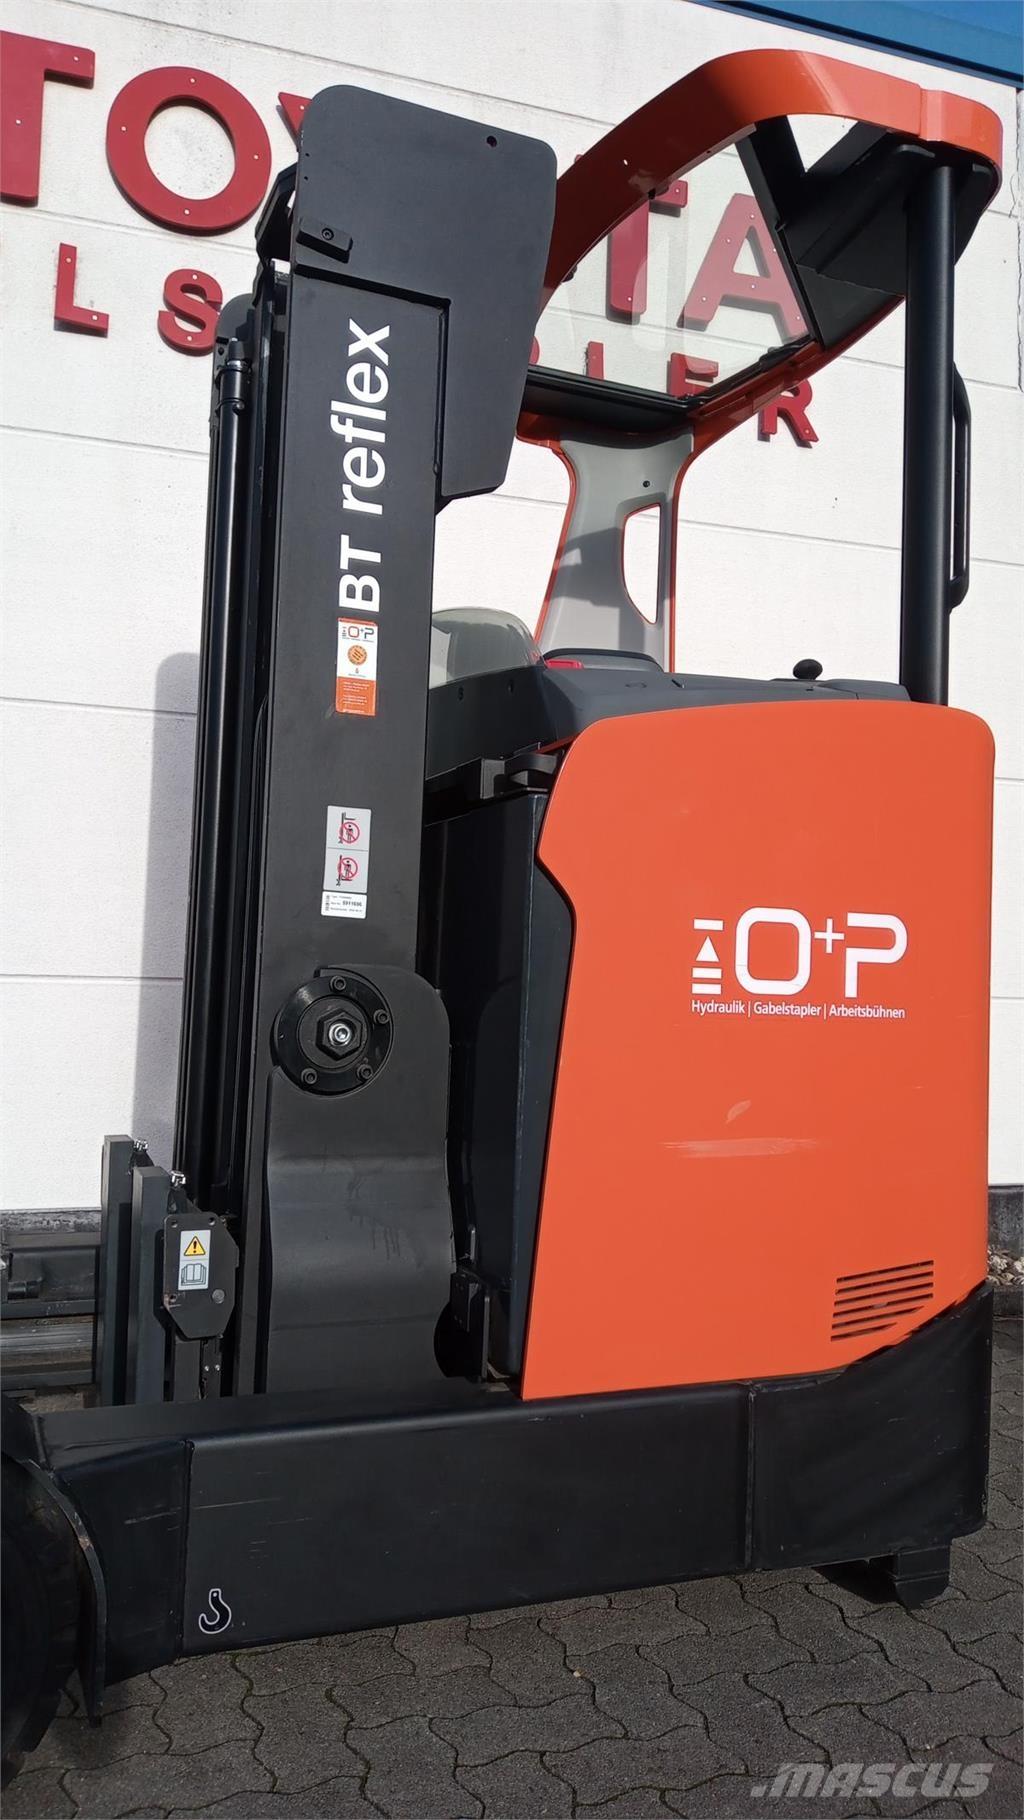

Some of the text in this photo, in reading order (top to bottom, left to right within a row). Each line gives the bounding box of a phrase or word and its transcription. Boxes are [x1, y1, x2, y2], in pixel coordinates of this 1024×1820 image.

[330, 318, 390, 515] reflex
[339, 534, 380, 612] BT
[735, 907, 908, 998] O+P
[692, 1000, 905, 1018] Hydraulik Gabelstapler Arbeitsbühnen
